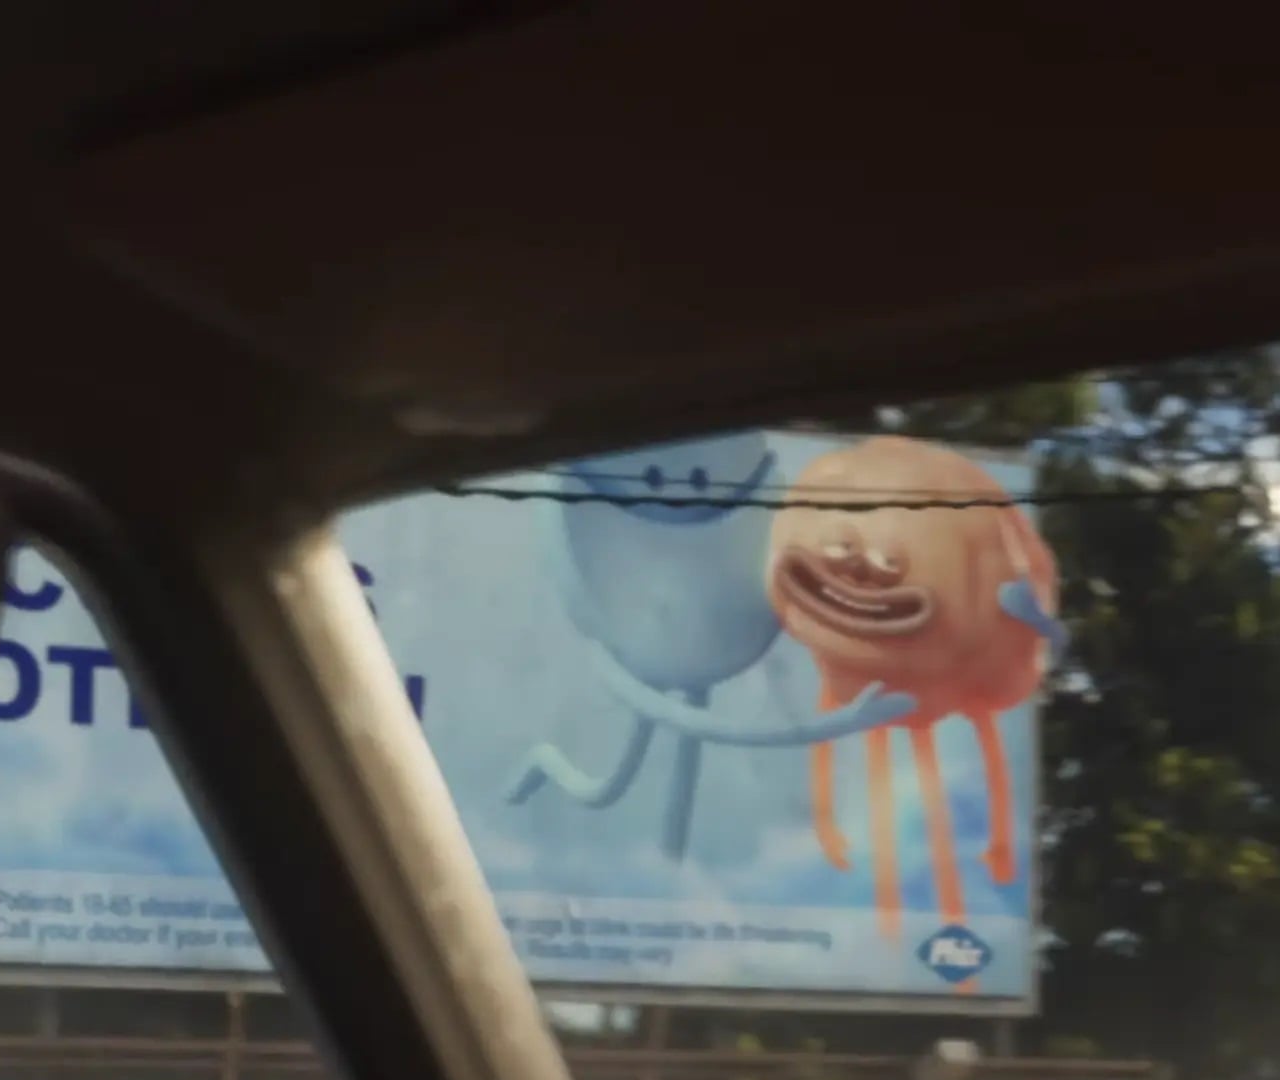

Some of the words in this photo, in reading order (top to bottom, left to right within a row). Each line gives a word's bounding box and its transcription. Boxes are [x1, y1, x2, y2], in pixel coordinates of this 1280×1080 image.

[37, 925, 81, 946] your
[86, 922, 151, 944] doctor
[157, 924, 172, 944] if
[175, 929, 218, 950] your
